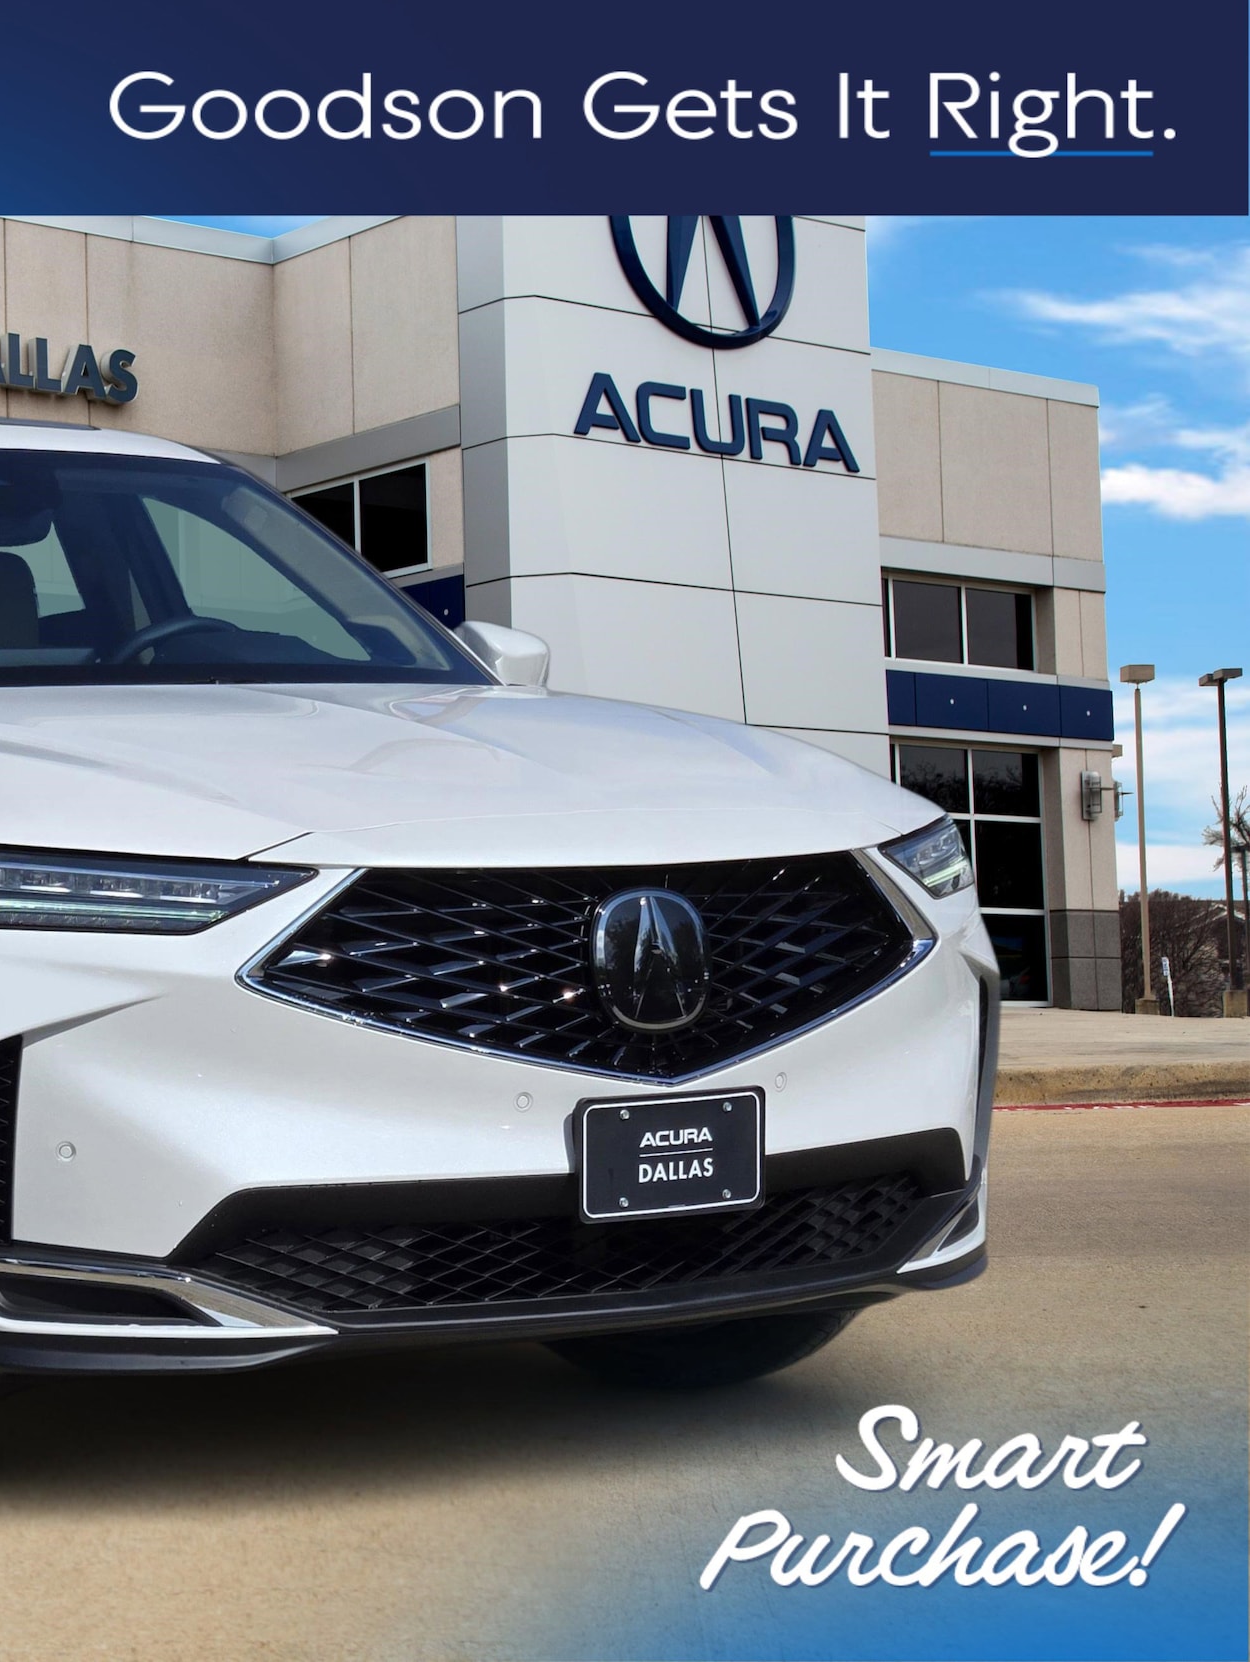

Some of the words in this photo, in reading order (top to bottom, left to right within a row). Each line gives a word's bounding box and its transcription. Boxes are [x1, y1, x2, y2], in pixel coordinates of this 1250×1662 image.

[573, 372, 860, 473] ACURA
[639, 1127, 713, 1148] ACURA
[638, 1158, 714, 1184] DALLAS
